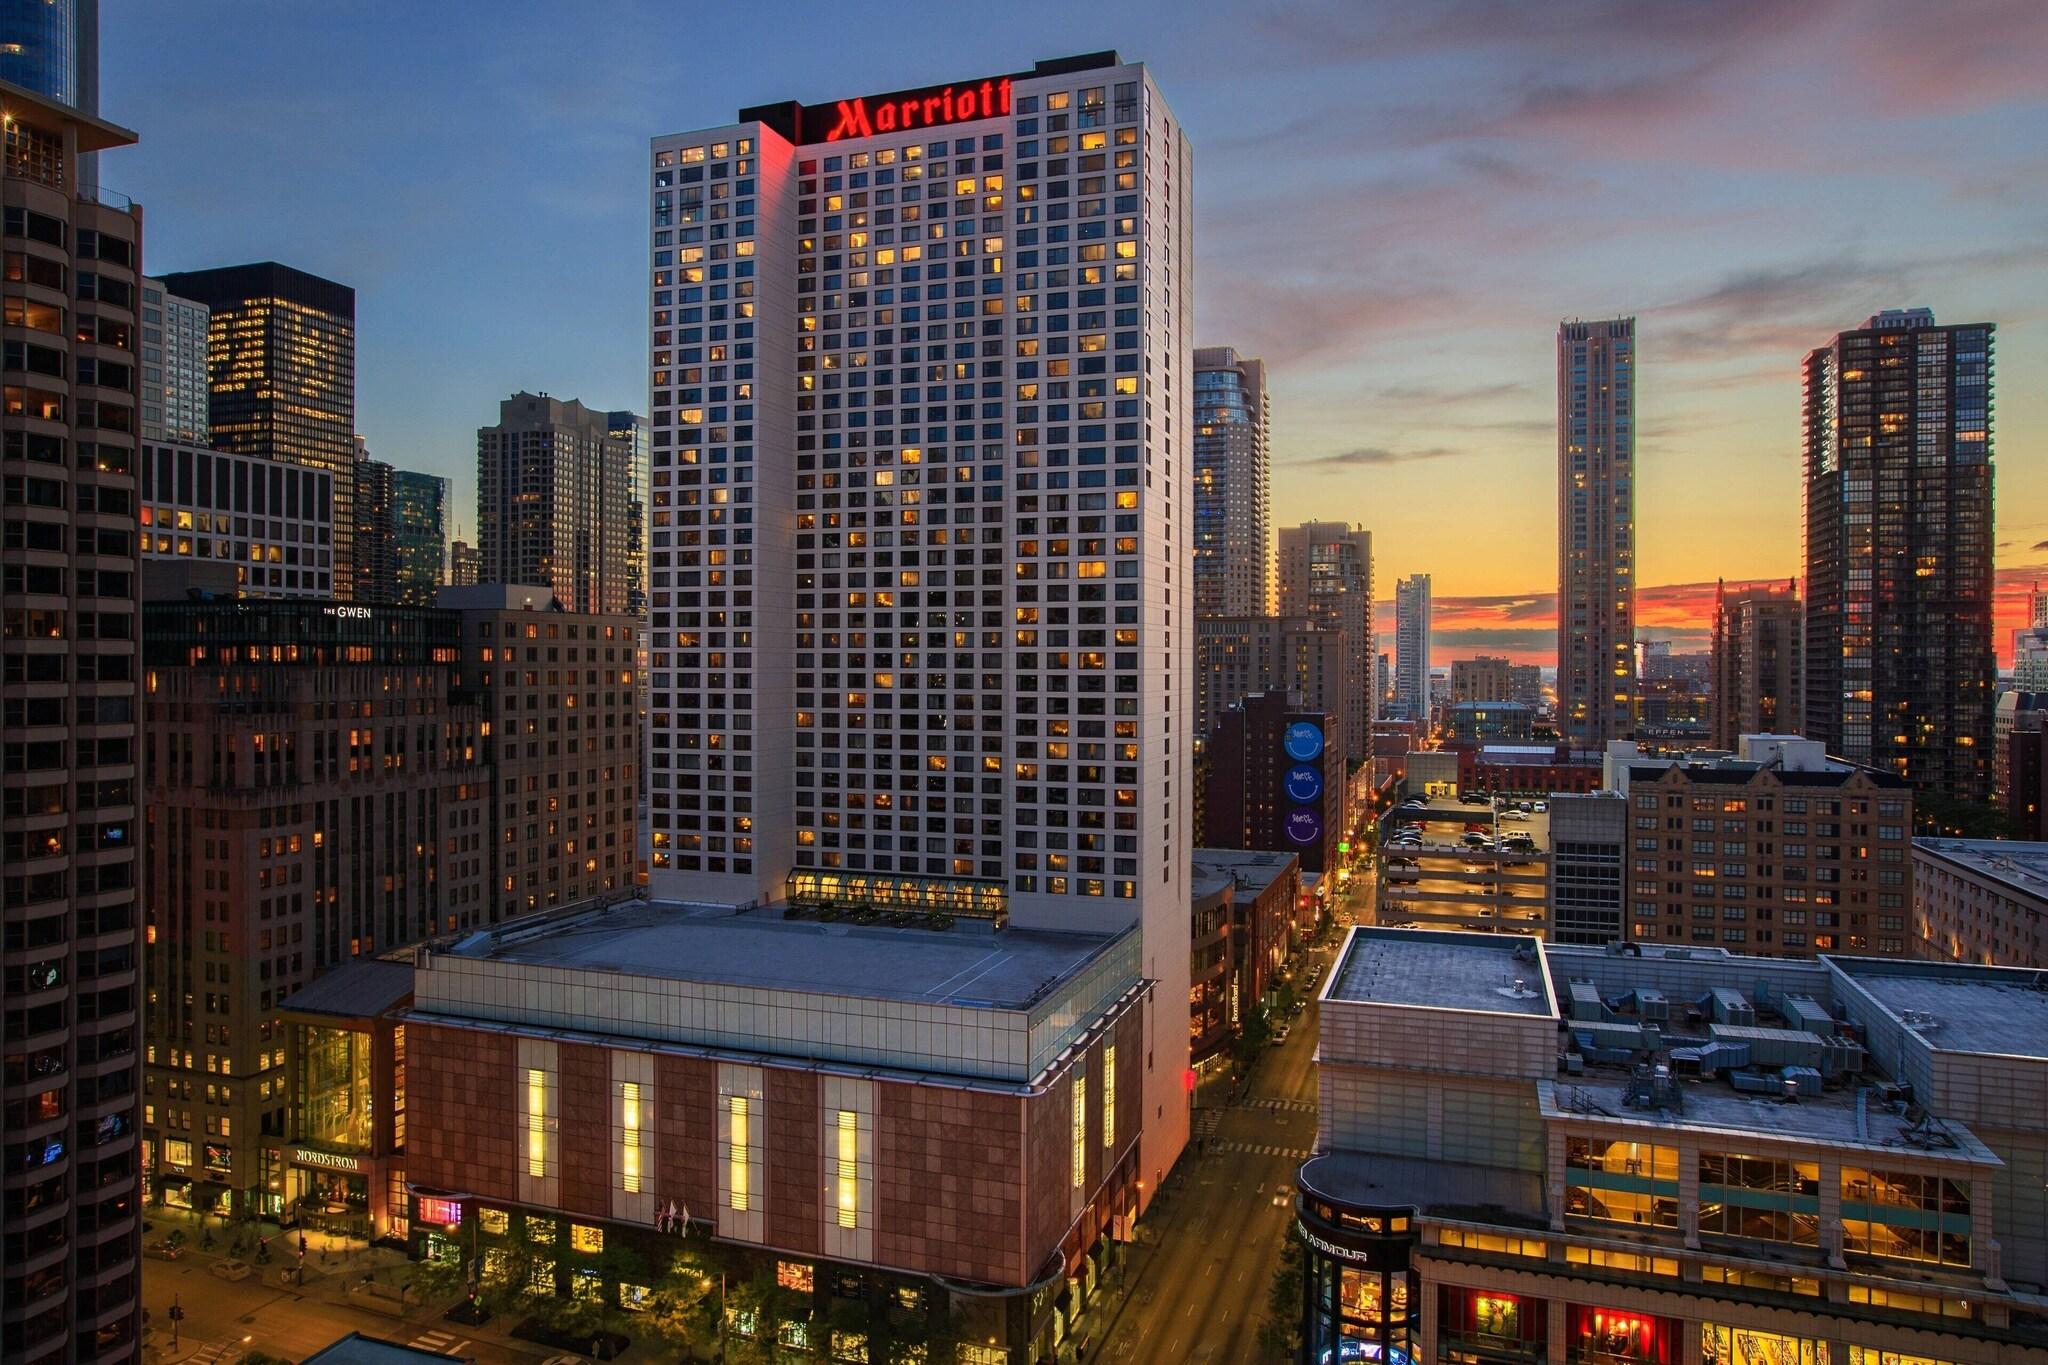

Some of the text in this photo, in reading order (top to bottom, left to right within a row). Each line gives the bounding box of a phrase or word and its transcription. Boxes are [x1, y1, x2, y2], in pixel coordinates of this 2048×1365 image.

[827, 78, 1012, 142] Marriott
[337, 606, 371, 618] GWEN
[296, 1149, 358, 1171] NORDSTROM
[1308, 1233, 1368, 1262] ARMOUR
